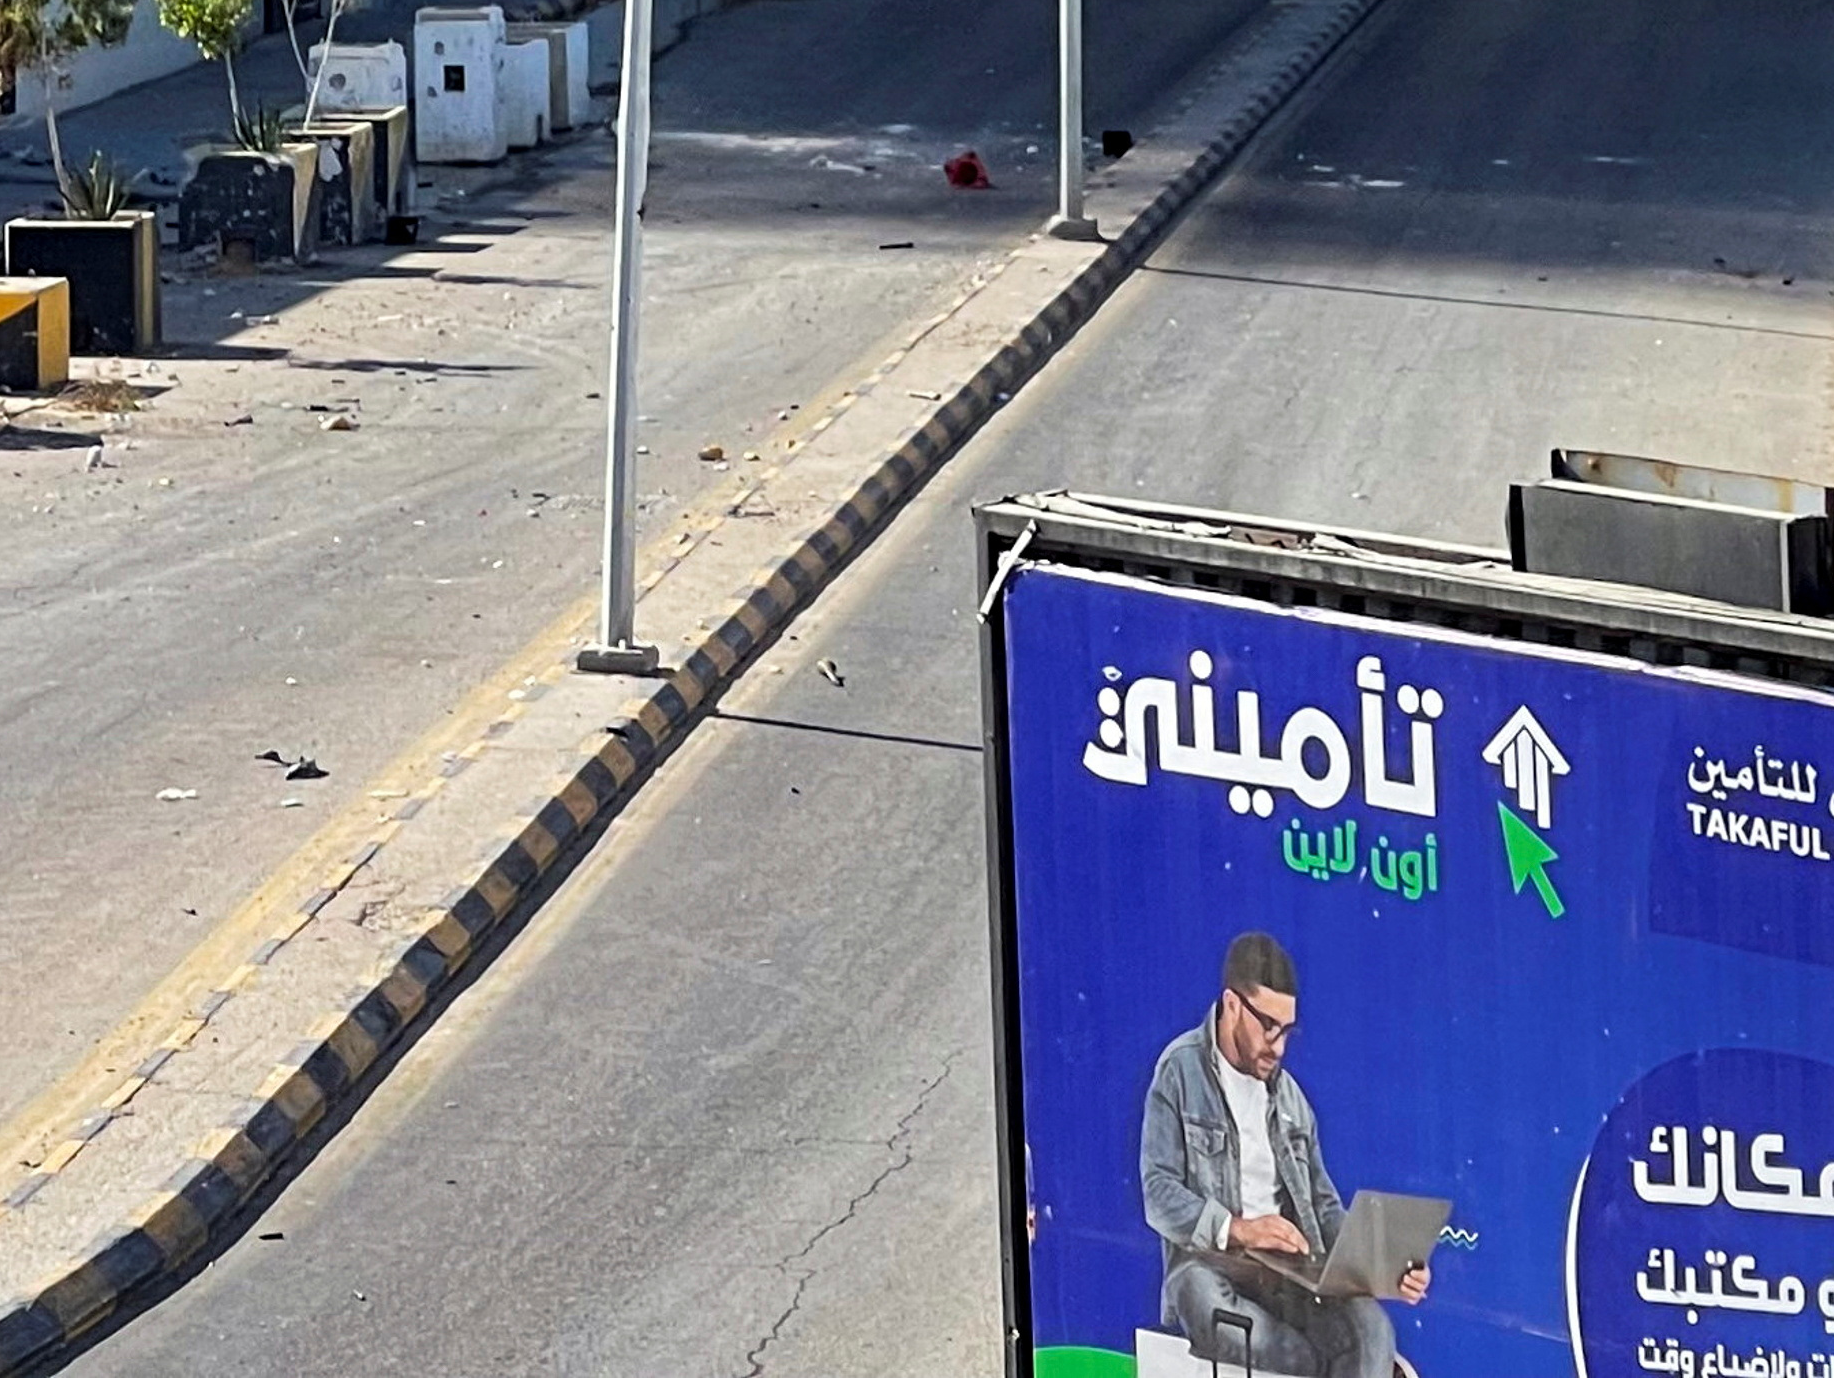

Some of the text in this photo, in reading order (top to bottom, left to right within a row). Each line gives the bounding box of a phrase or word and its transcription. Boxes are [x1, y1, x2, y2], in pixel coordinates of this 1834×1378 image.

[1081, 648, 1445, 819] تأميني
[1686, 745, 1818, 804] للتأمين
[1282, 817, 1439, 900] أون لاين
[1686, 802, 1831, 862] TAKAFUL
[1635, 1247, 1806, 1325] مكتبك
